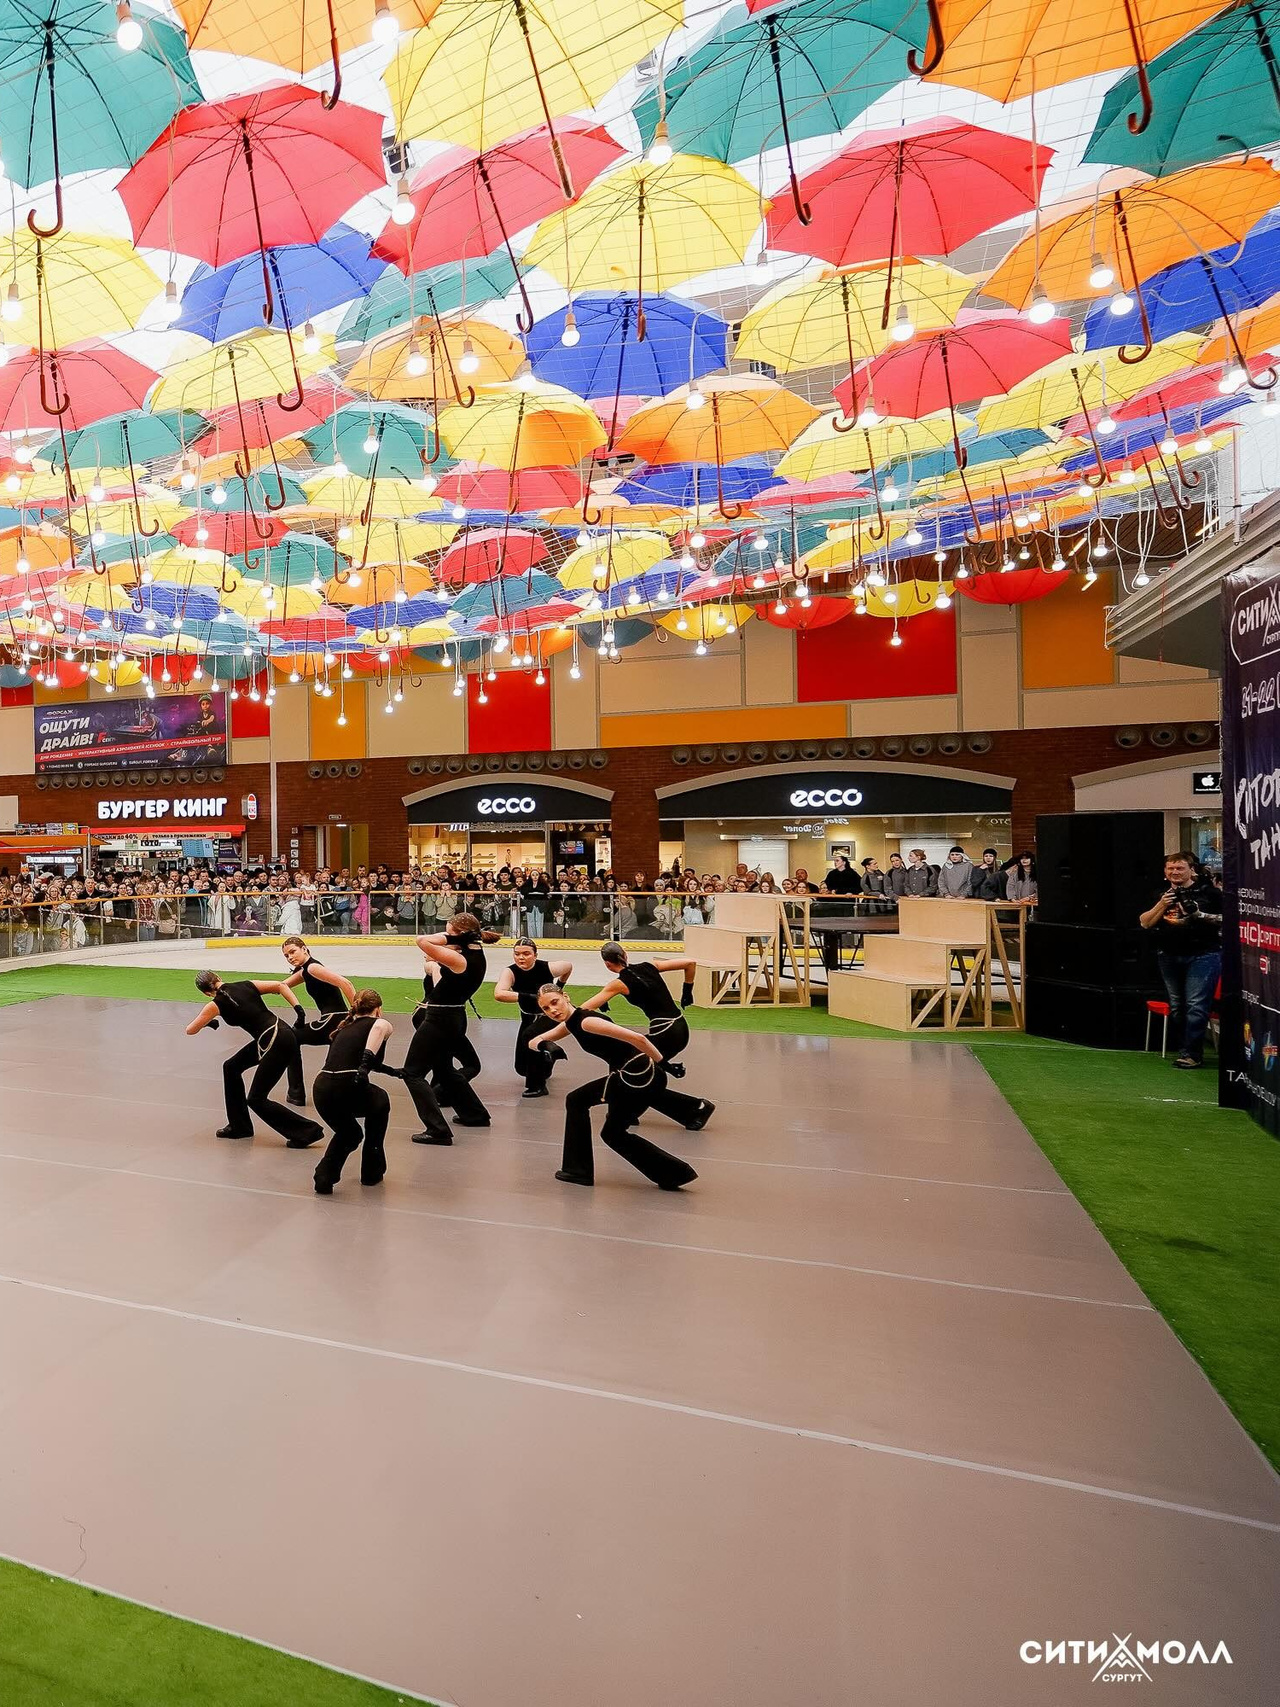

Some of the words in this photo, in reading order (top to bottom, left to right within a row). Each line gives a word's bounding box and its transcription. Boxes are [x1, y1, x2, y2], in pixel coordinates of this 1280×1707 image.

[1238, 597, 1269, 635] СИТИ
[39, 717, 91, 735] ОЩУТИ
[40, 732, 95, 753] ДРАЙВ!
[477, 797, 536, 814] ecco
[790, 788, 863, 808] ecco
[97, 799, 169, 820] БУРГЕР
[173, 797, 228, 818] КИНГ
